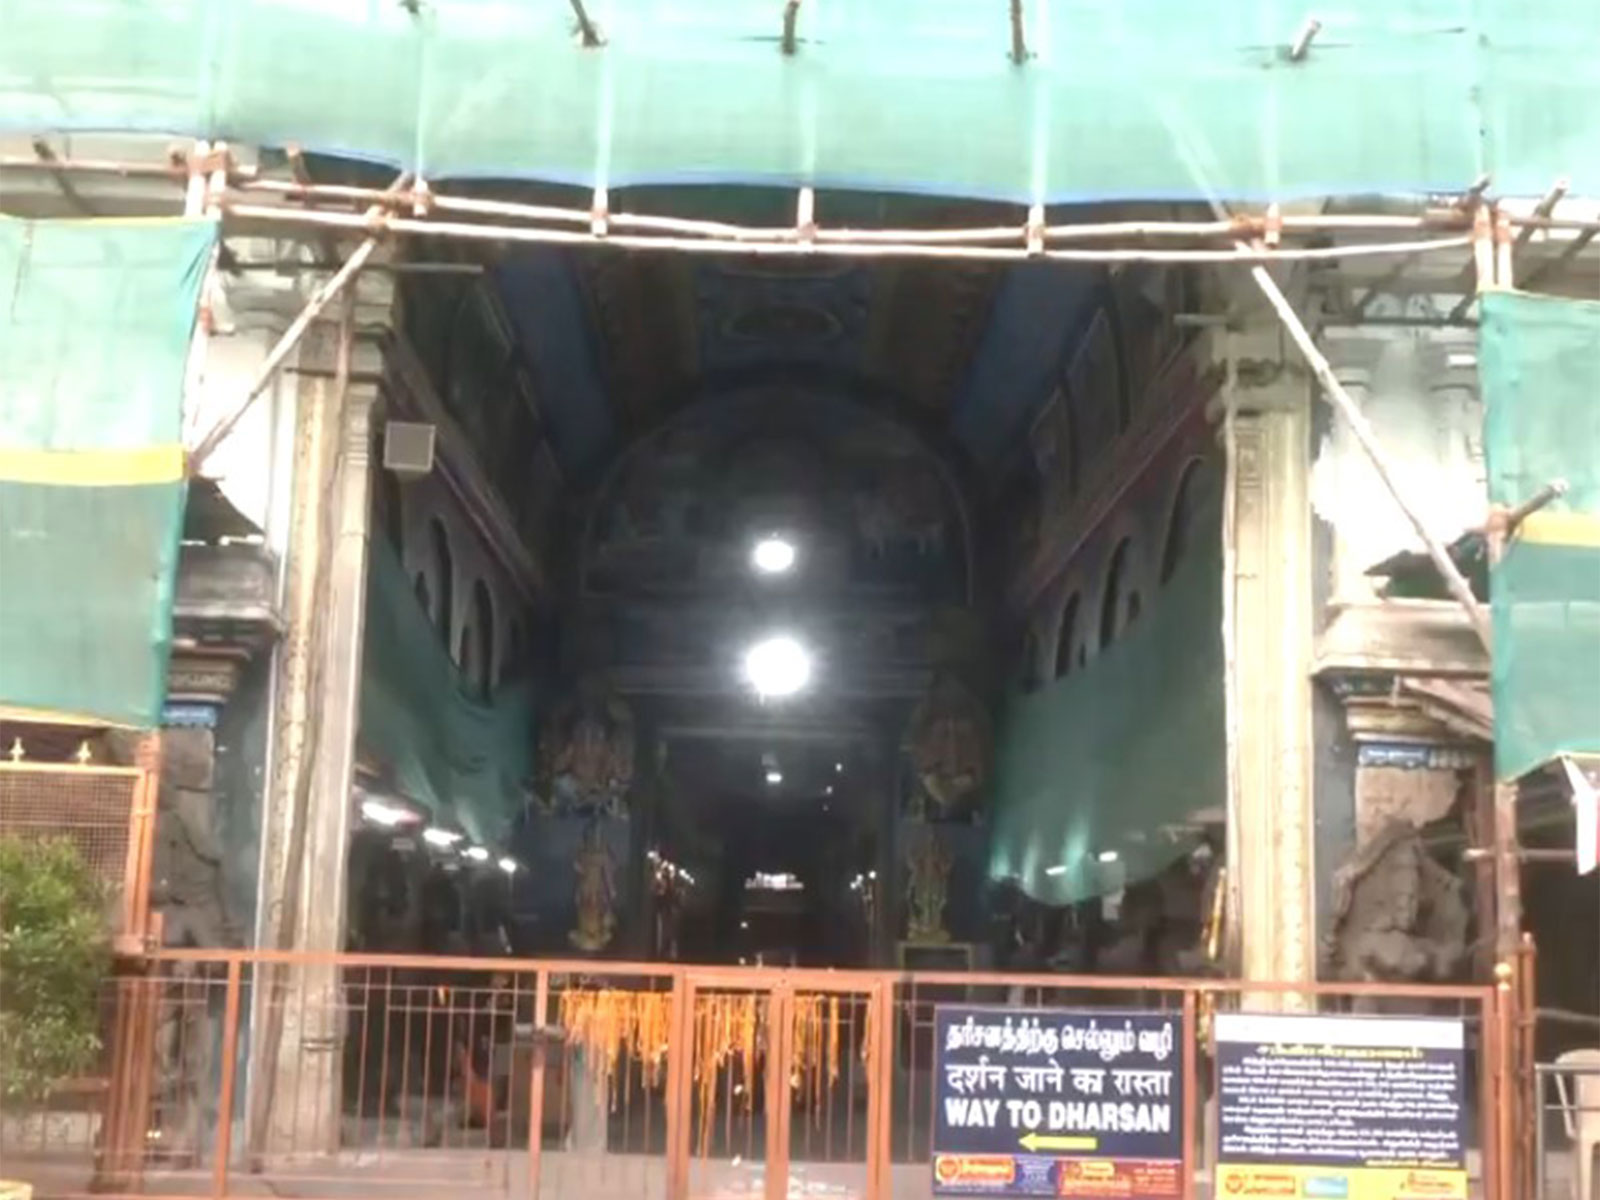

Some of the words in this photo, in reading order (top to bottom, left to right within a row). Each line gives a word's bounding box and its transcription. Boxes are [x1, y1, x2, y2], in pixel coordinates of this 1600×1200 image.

[1061, 1020, 1135, 1061] செல்லும்
[1138, 1022, 1173, 1061] வழி
[945, 1056, 1007, 1094] दर्शन
[1012, 1058, 1065, 1092] जाने
[1070, 1068, 1106, 1094] का
[1111, 1069, 1173, 1096] रास्ता
[945, 1097, 1001, 1128] WAY
[1006, 1099, 1043, 1129] TO
[1048, 1101, 1171, 1132] DHARSAN
